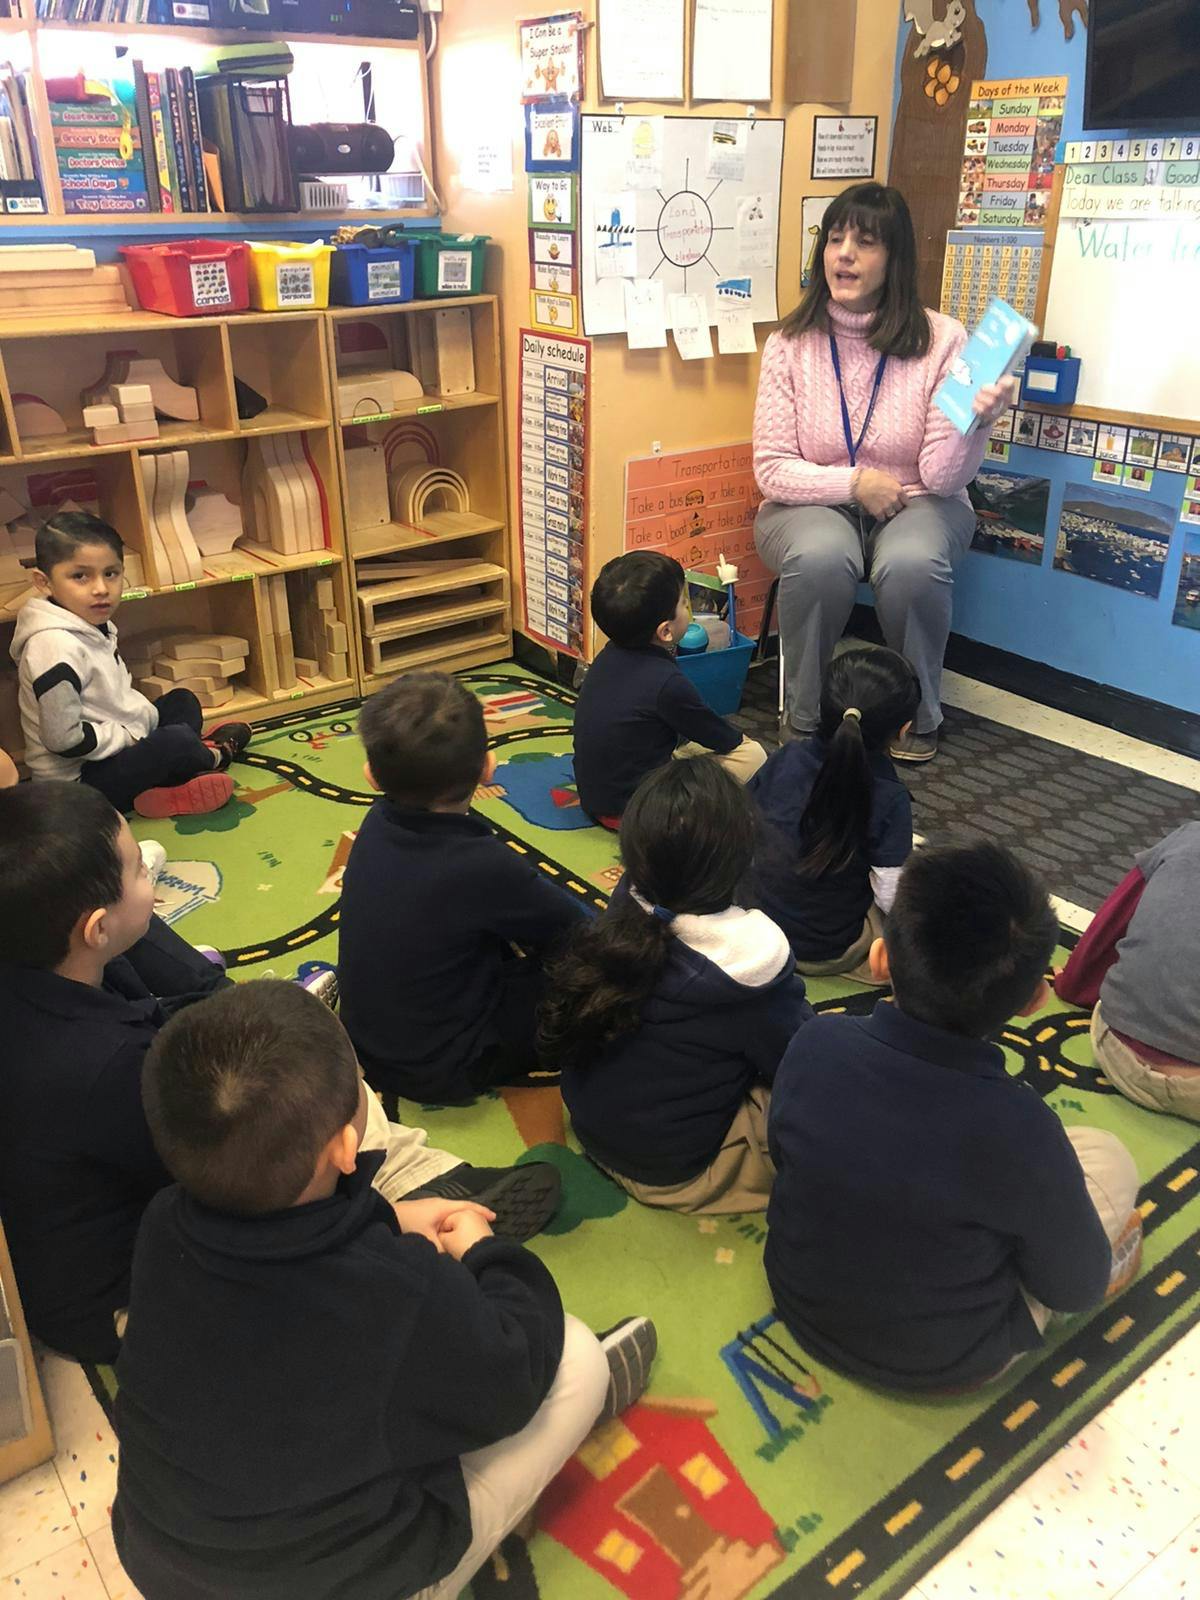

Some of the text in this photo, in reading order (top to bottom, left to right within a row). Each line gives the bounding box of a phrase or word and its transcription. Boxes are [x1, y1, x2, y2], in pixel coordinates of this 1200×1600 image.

[530, 28, 534, 39] I
[535, 27, 546, 38] Can
[530, 47, 548, 60] Super
[978, 82, 1059, 100] Days of the Week
[1000, 104, 1032, 118] Sunday
[592, 121, 614, 133] Web
[996, 124, 1030, 136] Monday
[62, 134, 96, 145] Grocery
[993, 142, 1029, 154] Tuesday
[1072, 142, 1193, 158] 1 2 3 4 5 6 7 8
[68, 158, 100, 168] Doctors
[987, 160, 1030, 172] Wednesday
[1066, 164, 1200, 184] Dear Class Good
[91, 178, 117, 190] Days
[536, 181, 550, 192] Way
[552, 181, 558, 190] to
[987, 178, 1026, 191] Thursday
[76, 199, 134, 211] Toy Store
[990, 196, 1018, 208] Friday
[1066, 187, 1100, 215] Today
[1107, 198, 1124, 210] we
[1130, 199, 1152, 211] are
[982, 214, 1020, 226] Saturday
[974, 236, 1018, 244] Numbers 1-100
[196, 294, 230, 306] carros
[524, 338, 584, 363] Daily schedule
[546, 372, 566, 388] Arrival
[1044, 438, 1058, 448] hat
[1098, 450, 1118, 460] juice
[672, 452, 752, 478] Transportation
[630, 482, 744, 515] Take a bus or take a
[628, 511, 743, 545] Take a boat or take a
[734, 544, 740, 552] a
